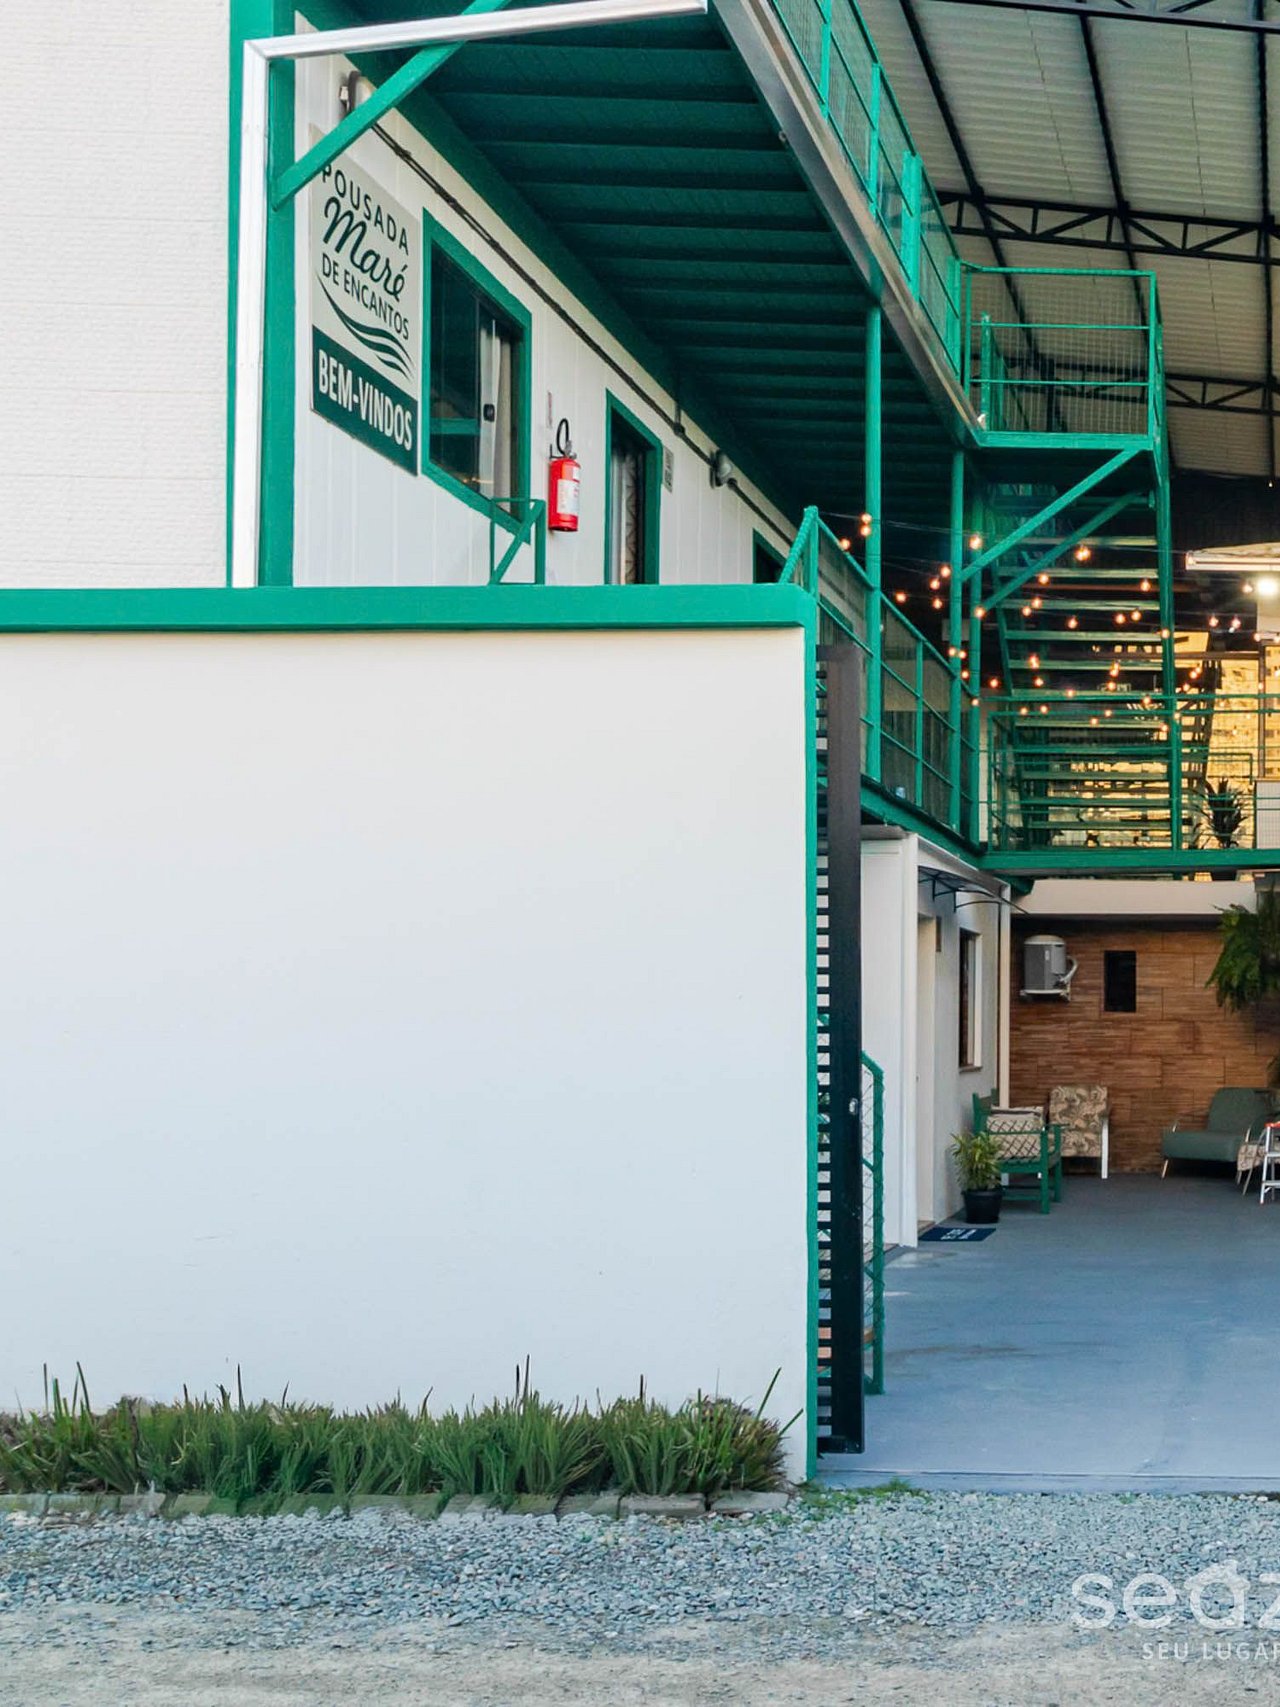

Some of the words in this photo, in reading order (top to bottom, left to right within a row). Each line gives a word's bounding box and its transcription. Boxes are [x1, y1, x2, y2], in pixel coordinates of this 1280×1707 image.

[322, 163, 409, 256] POUSADA
[323, 196, 408, 302] Maré
[322, 253, 339, 286] DE
[344, 269, 409, 340] ENCANTOS
[318, 349, 413, 451] BEM-VINDOS
